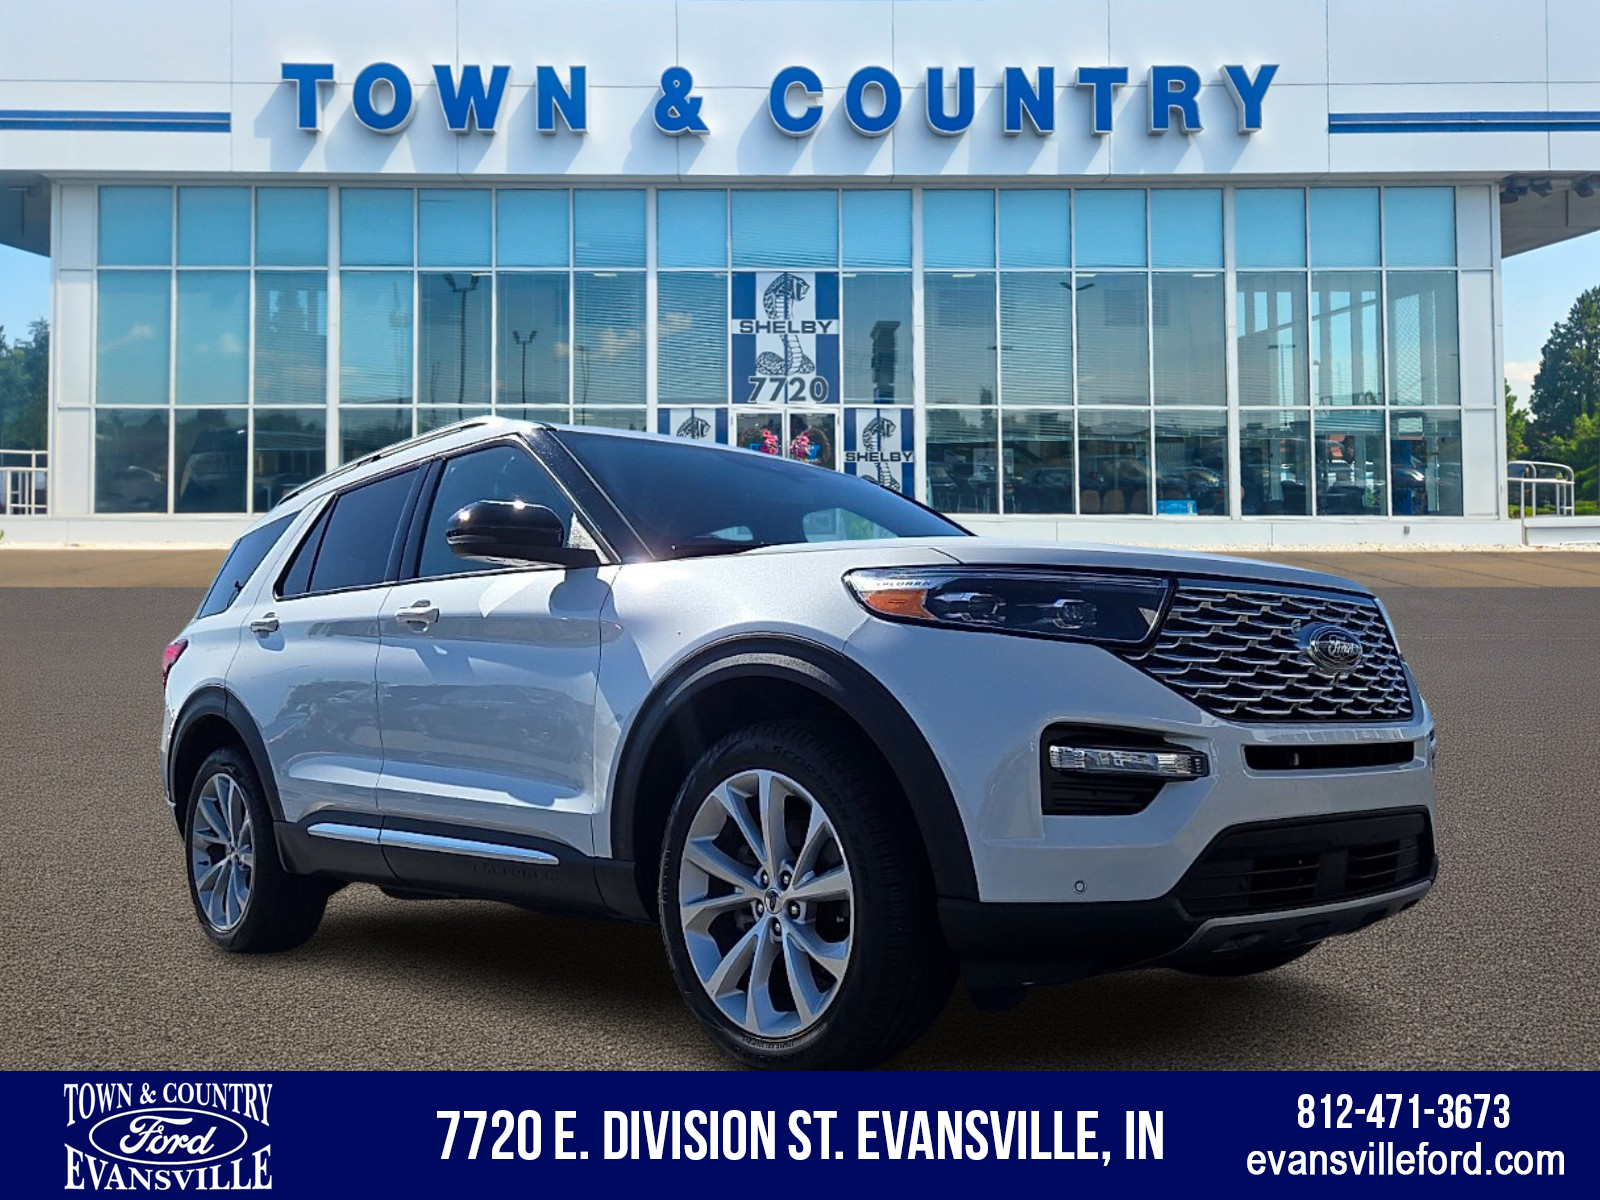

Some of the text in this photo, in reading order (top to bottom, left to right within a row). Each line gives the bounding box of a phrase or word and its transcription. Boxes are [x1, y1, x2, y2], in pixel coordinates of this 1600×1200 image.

[281, 62, 1279, 136] TOWN & COUNTRY
[739, 320, 833, 334] SHELBY
[748, 376, 829, 403] 7720
[845, 451, 914, 463] SHELBY
